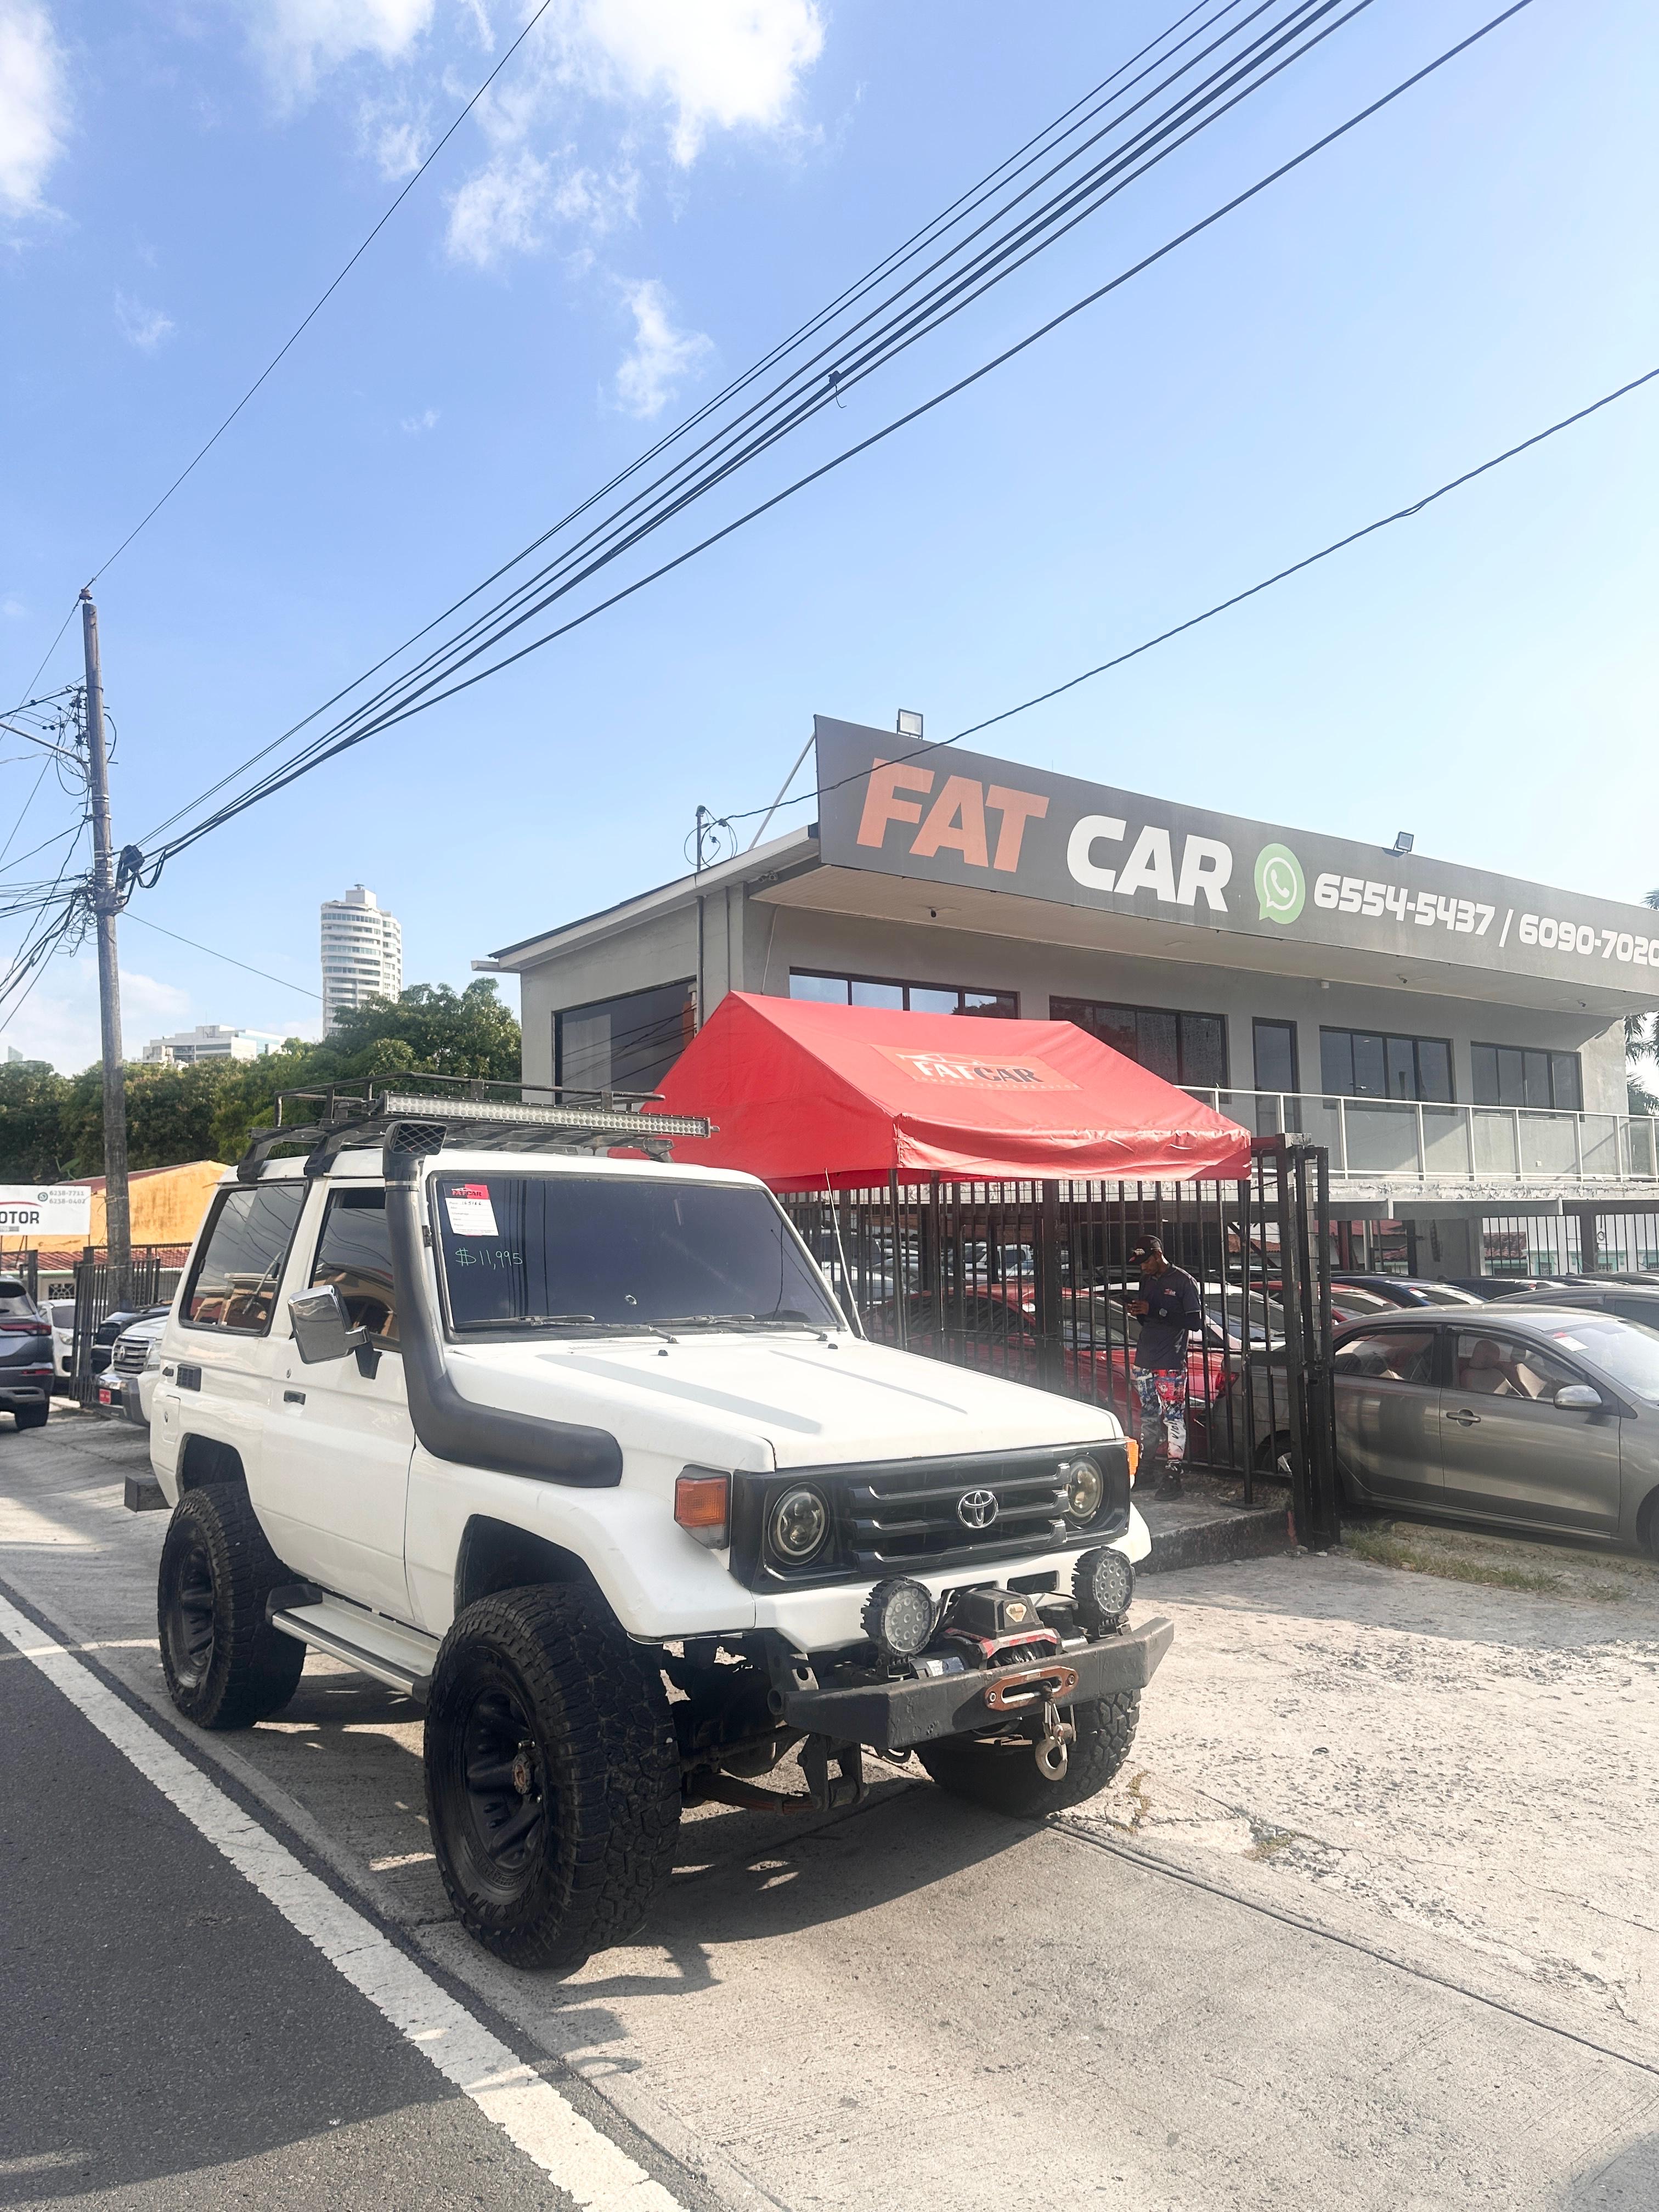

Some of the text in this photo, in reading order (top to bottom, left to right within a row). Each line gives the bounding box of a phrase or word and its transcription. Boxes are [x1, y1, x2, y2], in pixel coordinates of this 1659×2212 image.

[856, 758, 1233, 913] FAT CAR
[1313, 872, 1659, 967] 6554-5437 / 6090-7020
[455, 1247, 523, 1271] $11,995
